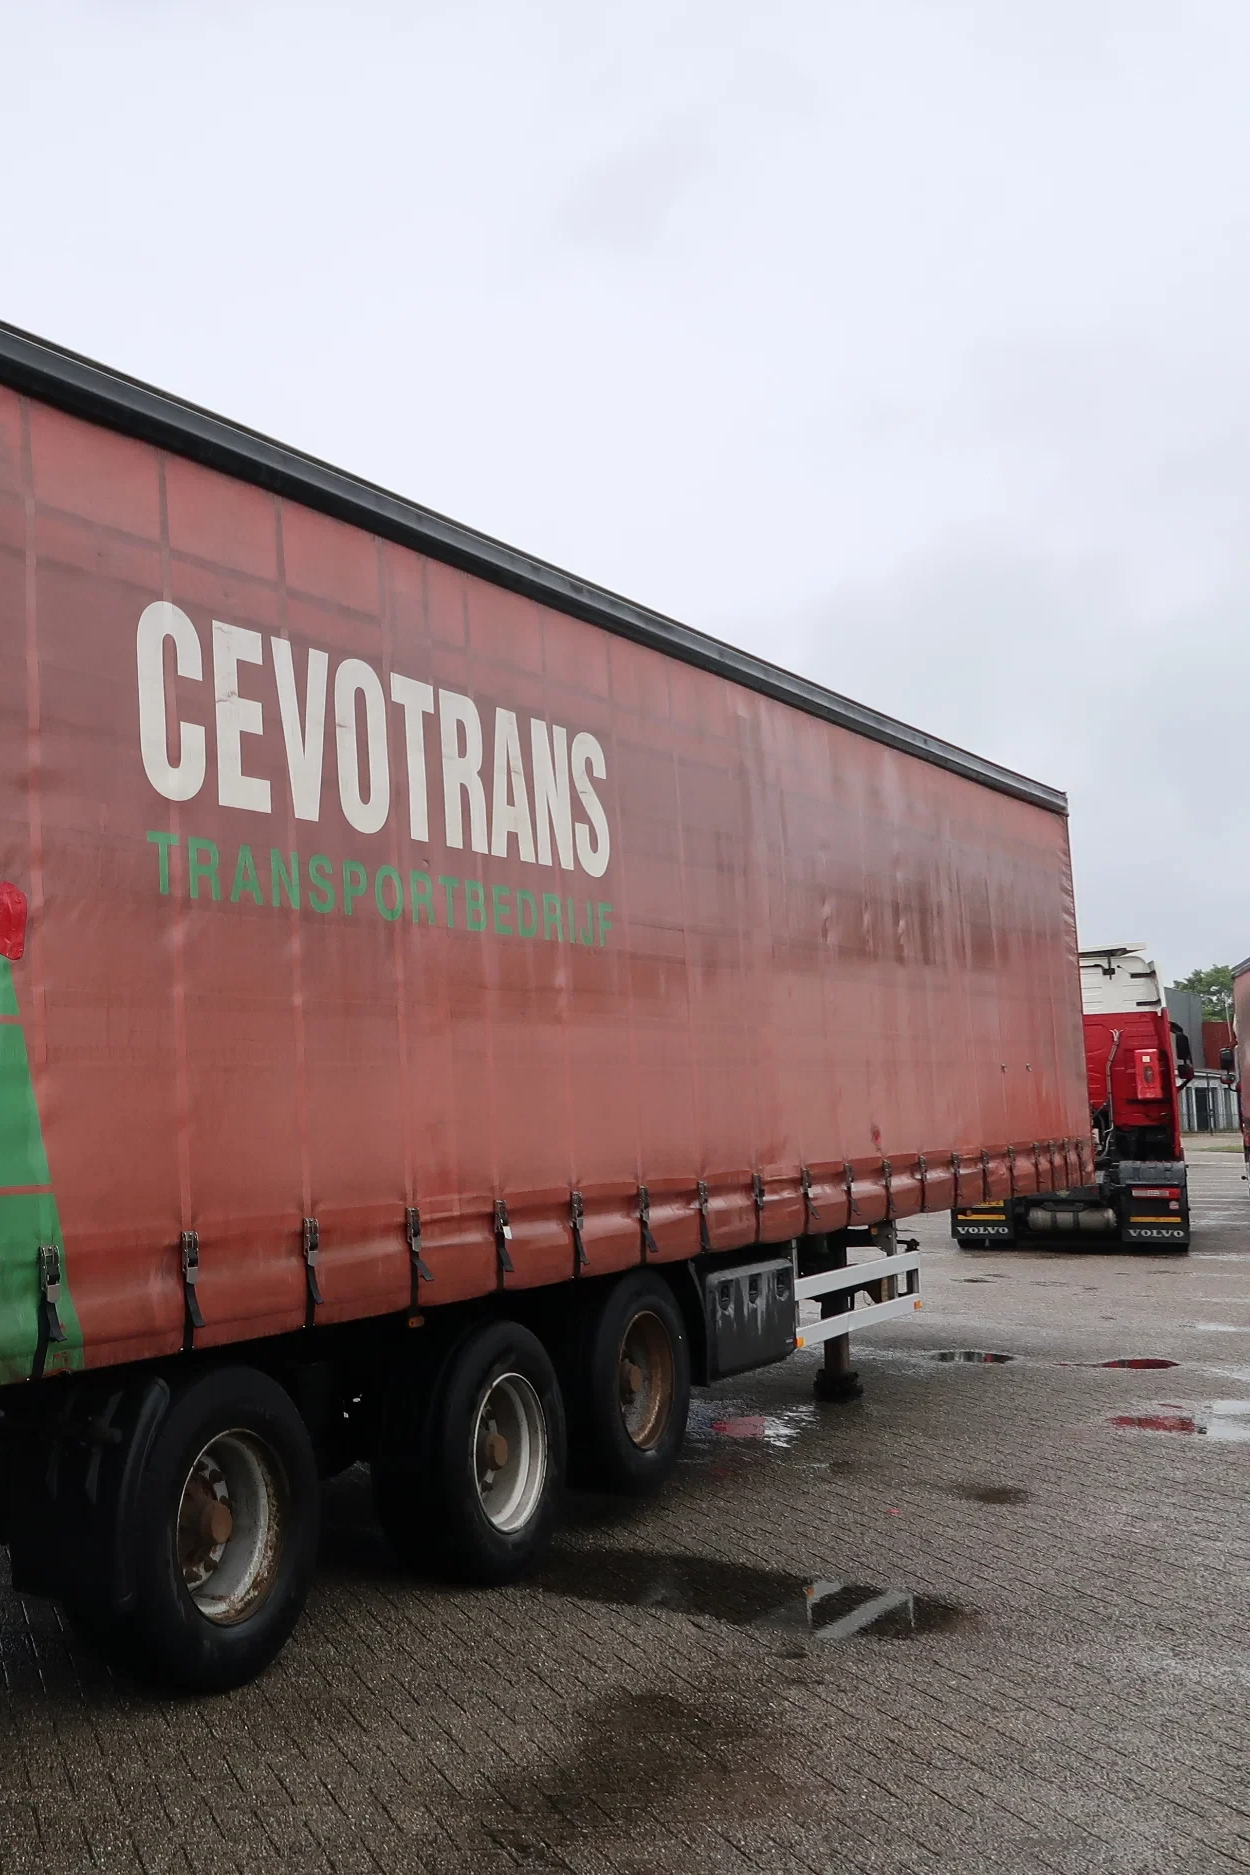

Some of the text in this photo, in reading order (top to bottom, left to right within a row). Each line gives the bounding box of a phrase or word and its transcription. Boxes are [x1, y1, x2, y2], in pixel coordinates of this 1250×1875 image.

[136, 600, 611, 878] CEVOTRANS
[146, 830, 614, 947] TRANSPORTBEDRIJF
[956, 1226, 1009, 1235] VOLVO
[1127, 1228, 1185, 1238] VOLVO
